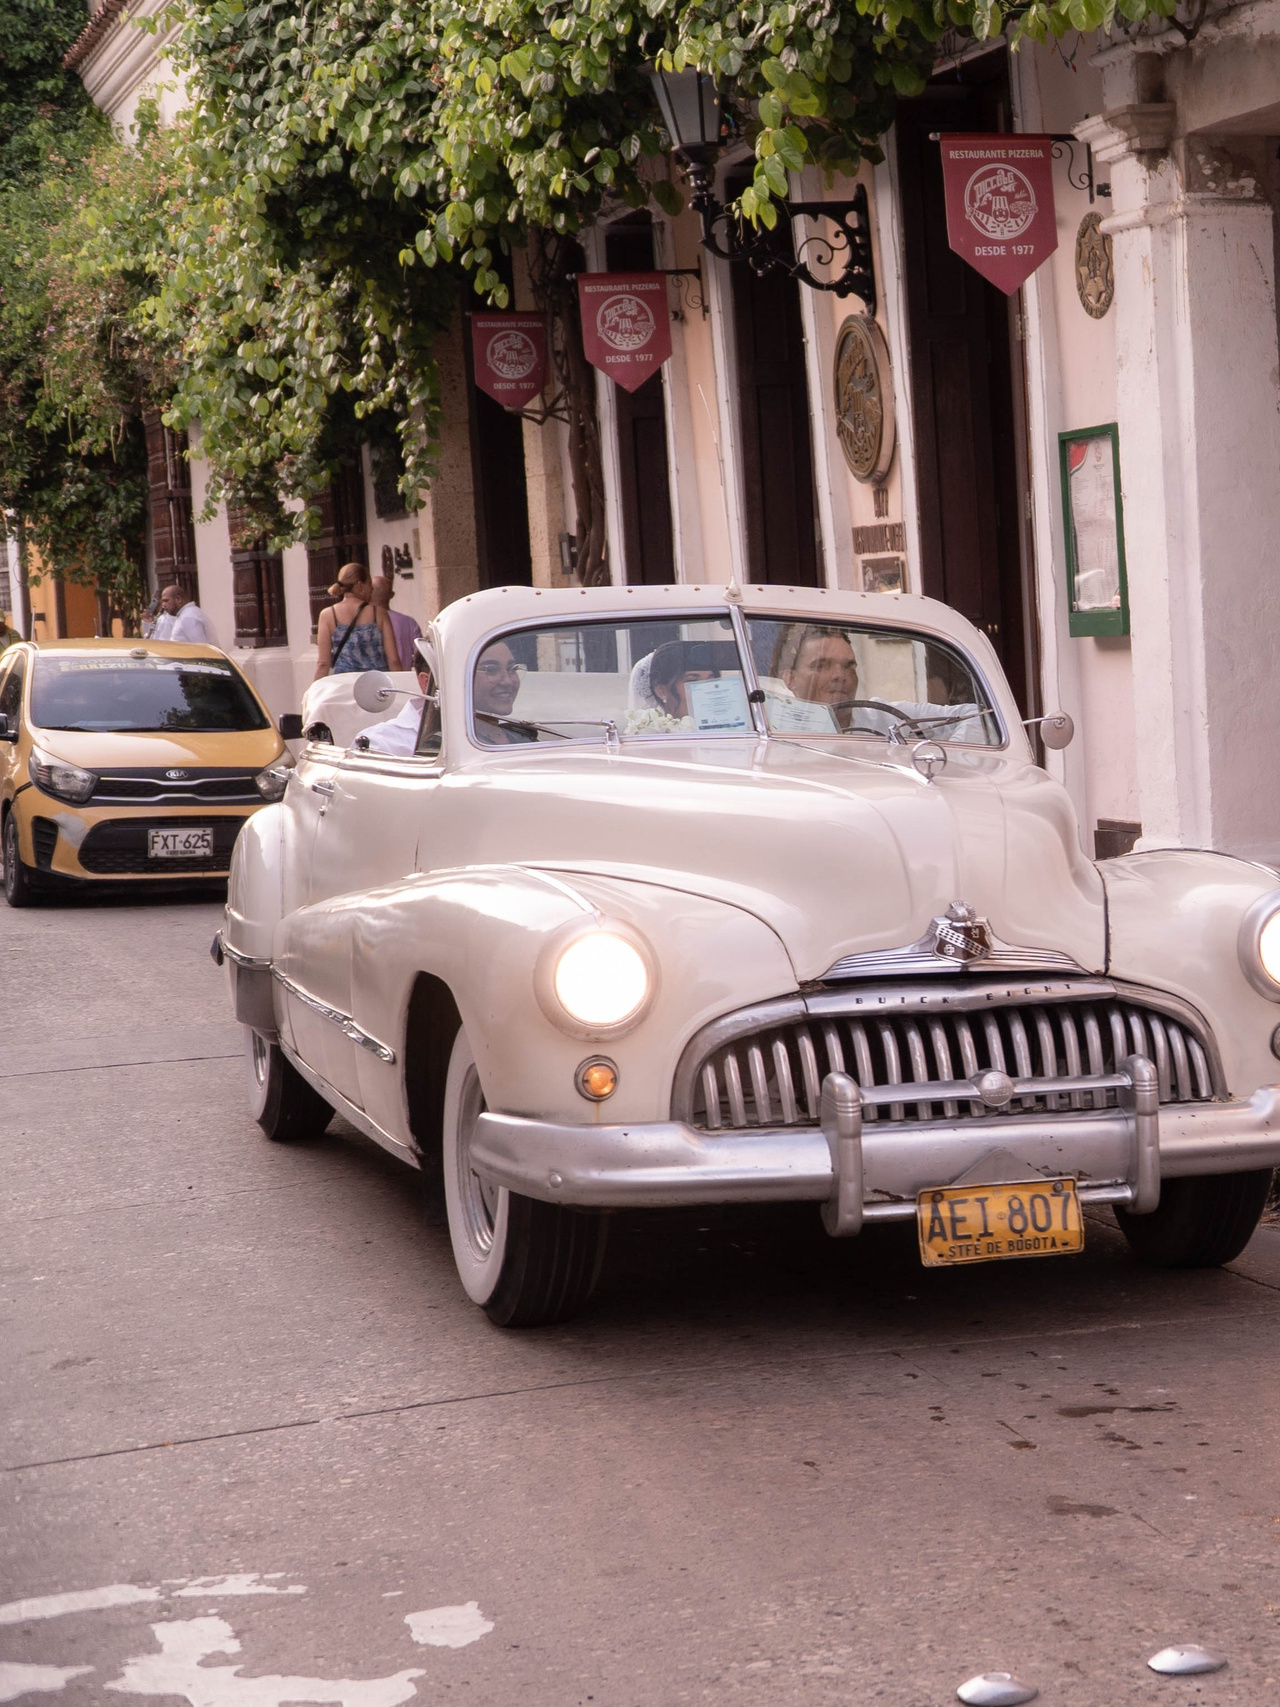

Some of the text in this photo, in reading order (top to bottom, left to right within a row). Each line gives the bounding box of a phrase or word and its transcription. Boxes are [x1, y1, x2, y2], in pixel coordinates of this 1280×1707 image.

[950, 149, 1044, 159] RESTAURANTE PIZZERIA
[975, 245, 1035, 256] DESDE 1977
[584, 283, 661, 293] RESTAURANTE PIZZERIA
[605, 354, 653, 363] DESDE 1977
[519, 382, 535, 390] 1977
[151, 833, 211, 850] FXT 625
[856, 984, 1072, 1004] BUICK EIGHT
[928, 1191, 1071, 1243] AEI 807
[949, 1236, 1058, 1258] STFE DE BOGOTA
